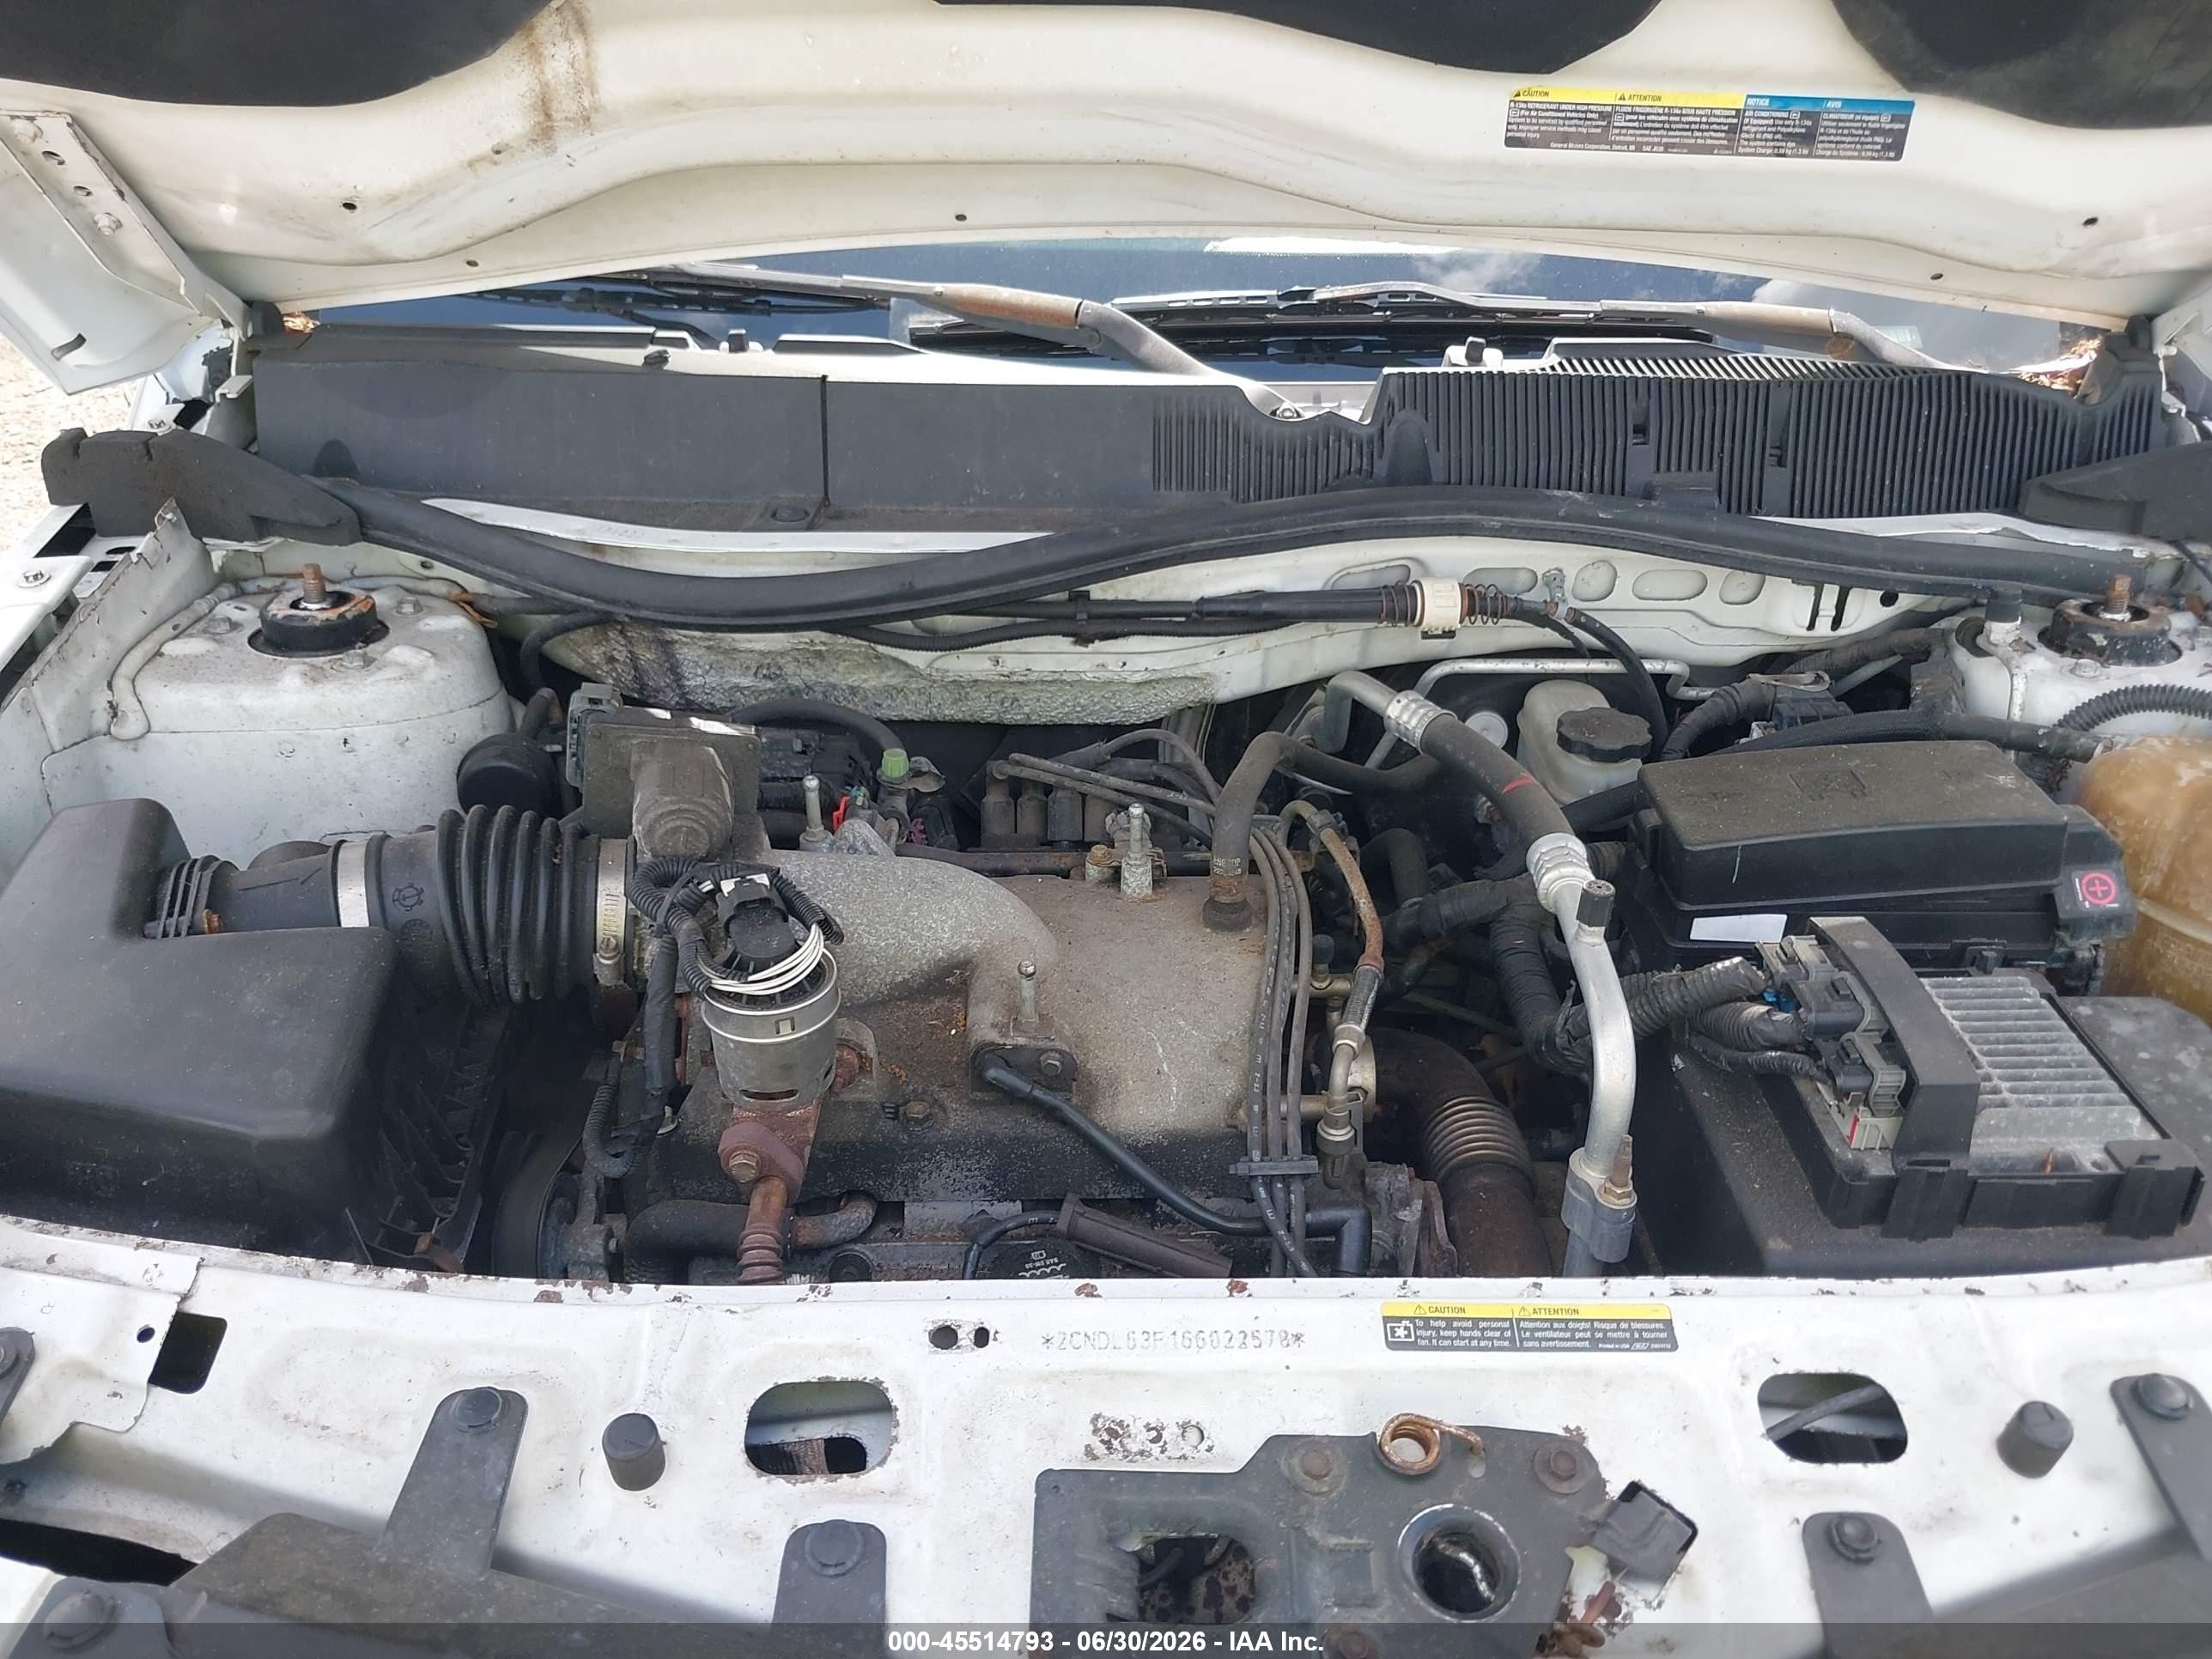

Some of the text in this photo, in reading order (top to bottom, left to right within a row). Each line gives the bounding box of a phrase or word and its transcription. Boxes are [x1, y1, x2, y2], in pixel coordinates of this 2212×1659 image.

[1430, 1319, 1445, 1328] help
[1479, 1320, 1510, 1328] personal
[1568, 1321, 1591, 1330] doigts!
[1440, 1329, 1457, 1338] keep
